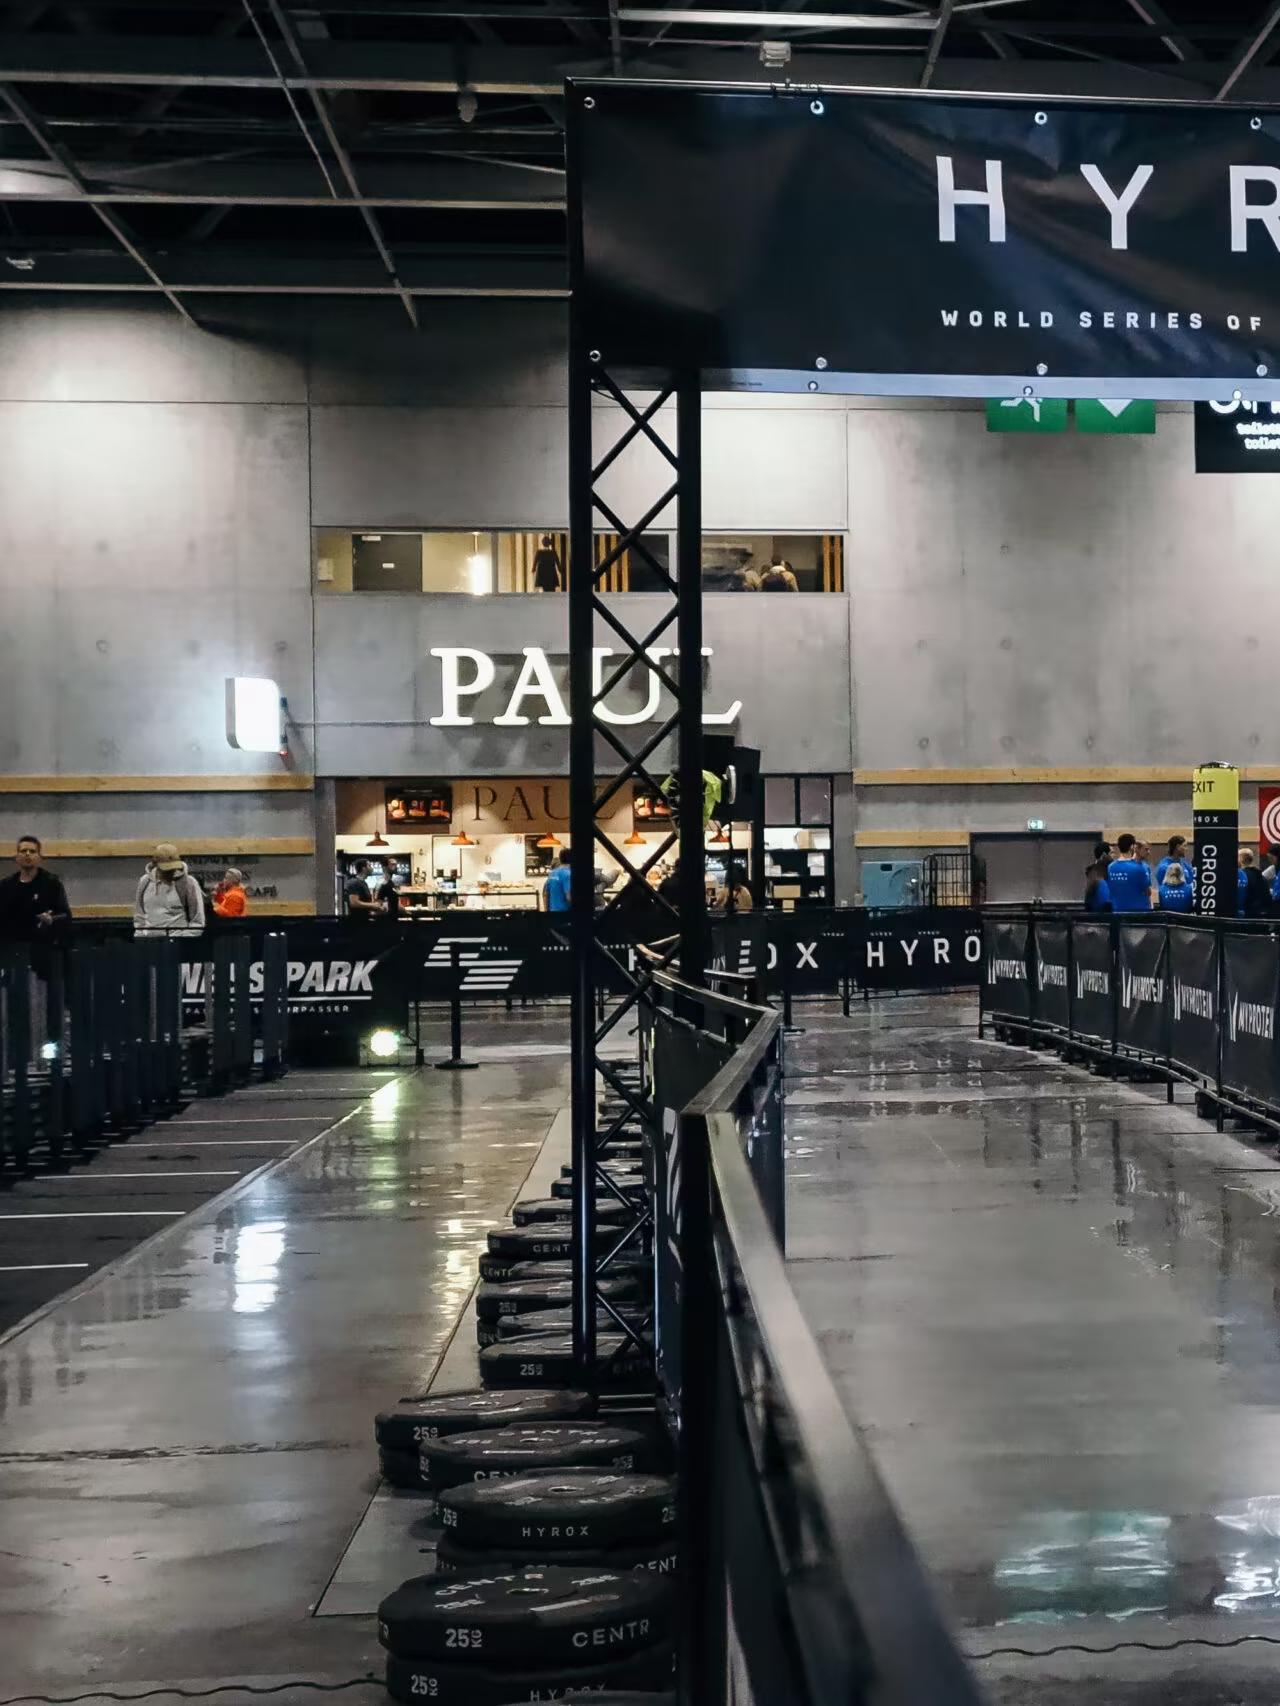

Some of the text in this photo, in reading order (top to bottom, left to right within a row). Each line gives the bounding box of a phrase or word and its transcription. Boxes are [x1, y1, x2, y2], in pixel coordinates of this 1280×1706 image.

[941, 309, 1053, 329] WORLD
[1079, 310, 1203, 330] SERIES
[1226, 314, 1262, 331] OF
[285, 960, 379, 993] PARK
[1237, 1001, 1274, 1040] MYPROTEIN
[522, 1526, 589, 1537] HYROX
[572, 1619, 650, 1647] CENTR
